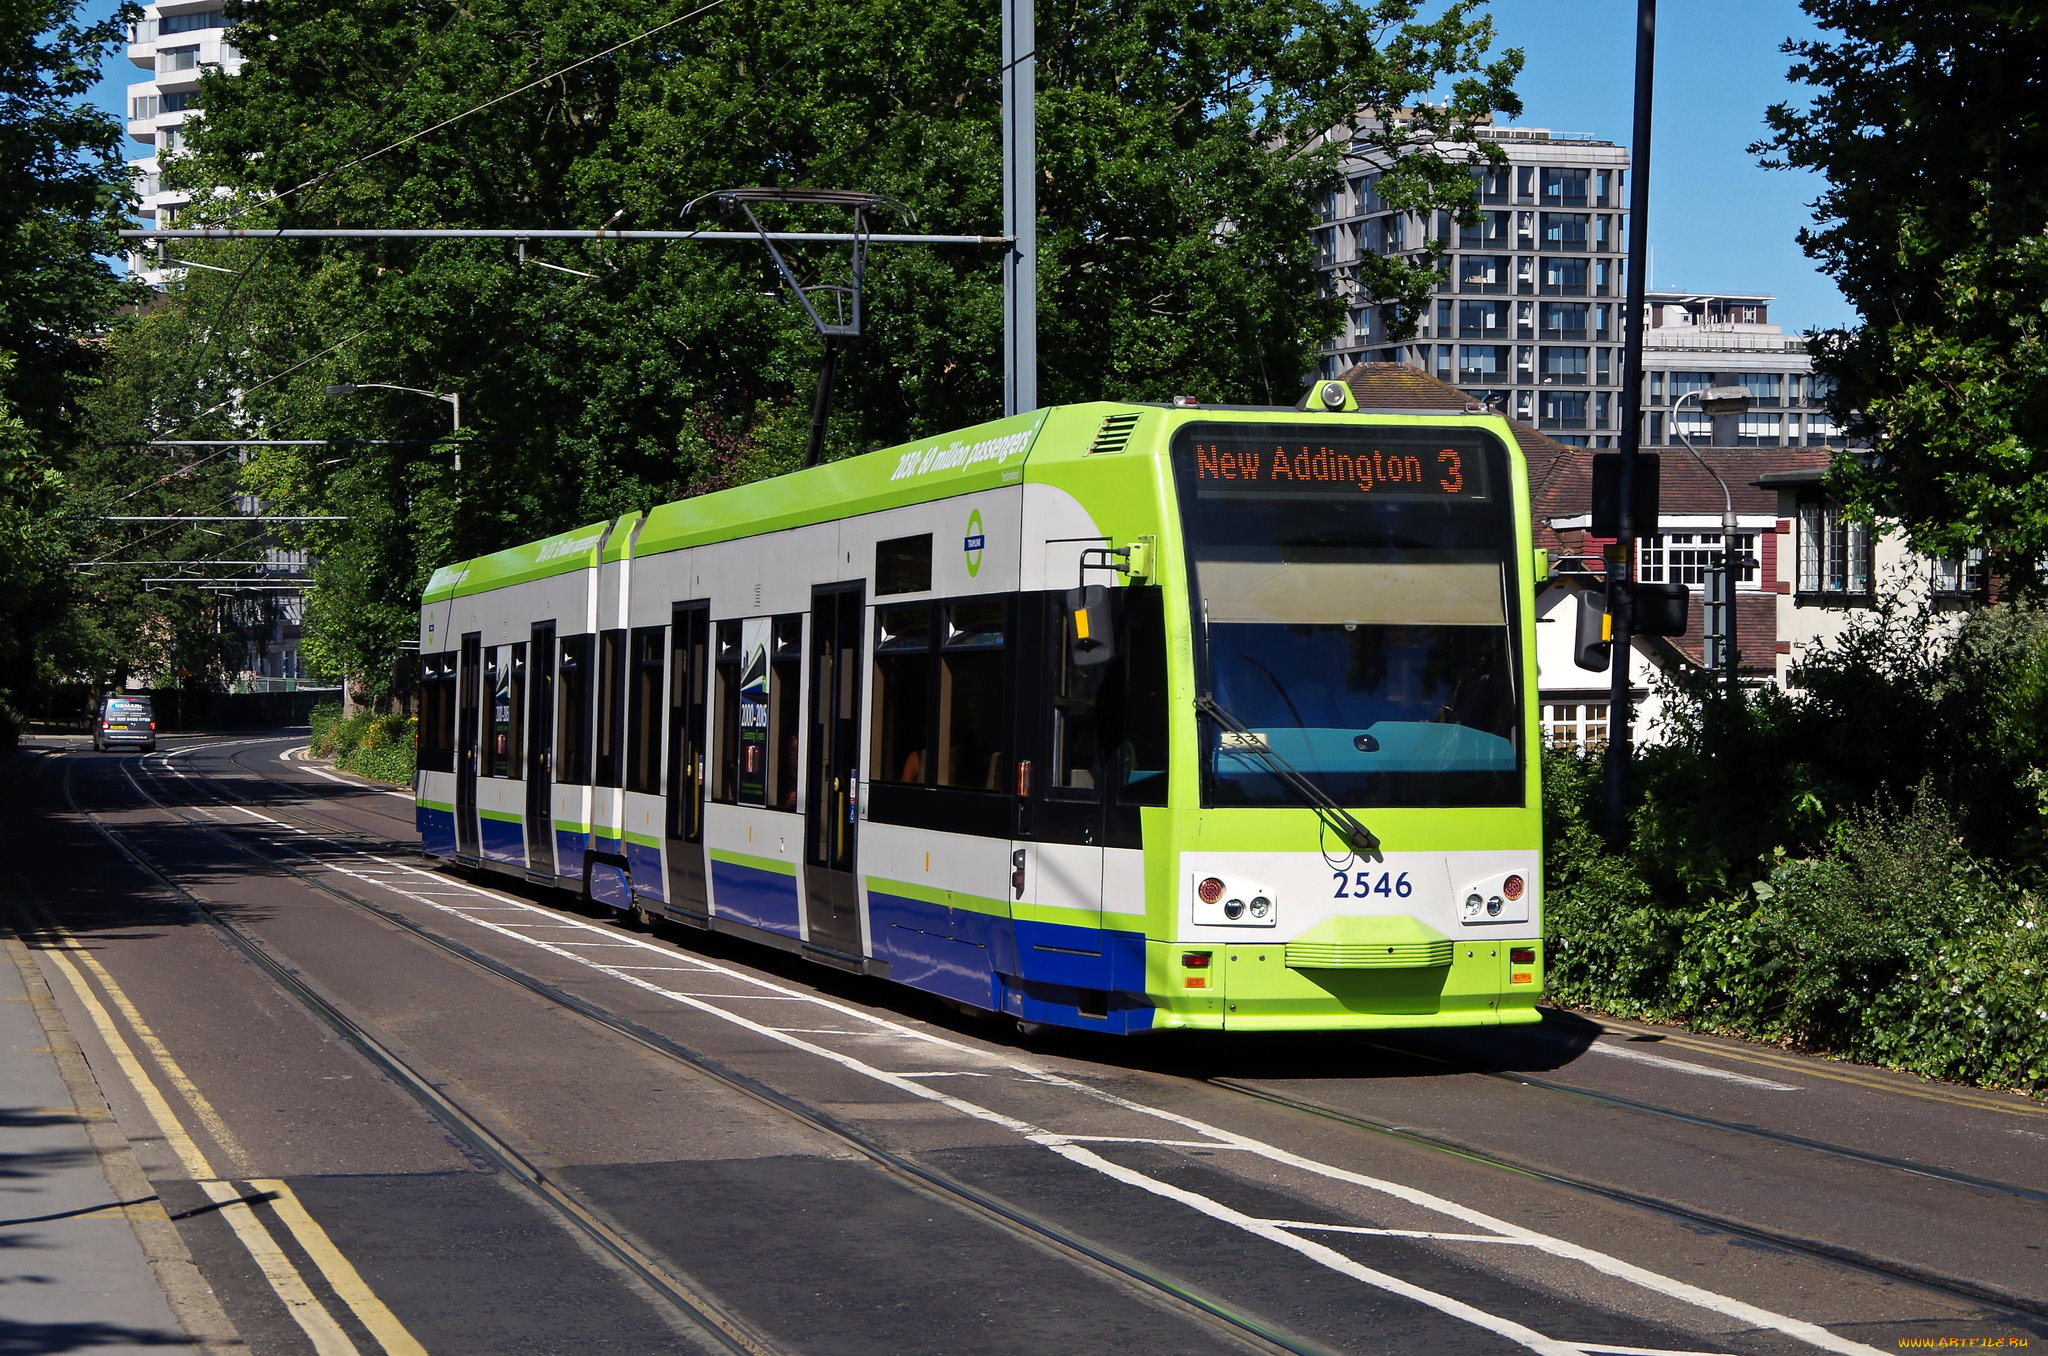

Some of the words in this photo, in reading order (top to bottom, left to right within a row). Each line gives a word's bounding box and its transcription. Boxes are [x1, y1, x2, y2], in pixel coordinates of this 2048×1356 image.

[930, 440, 970, 473] million
[1196, 444, 1260, 480] New
[1271, 445, 1422, 492] Addington
[1437, 449, 1464, 493] 3
[1333, 871, 1412, 899] 2546
